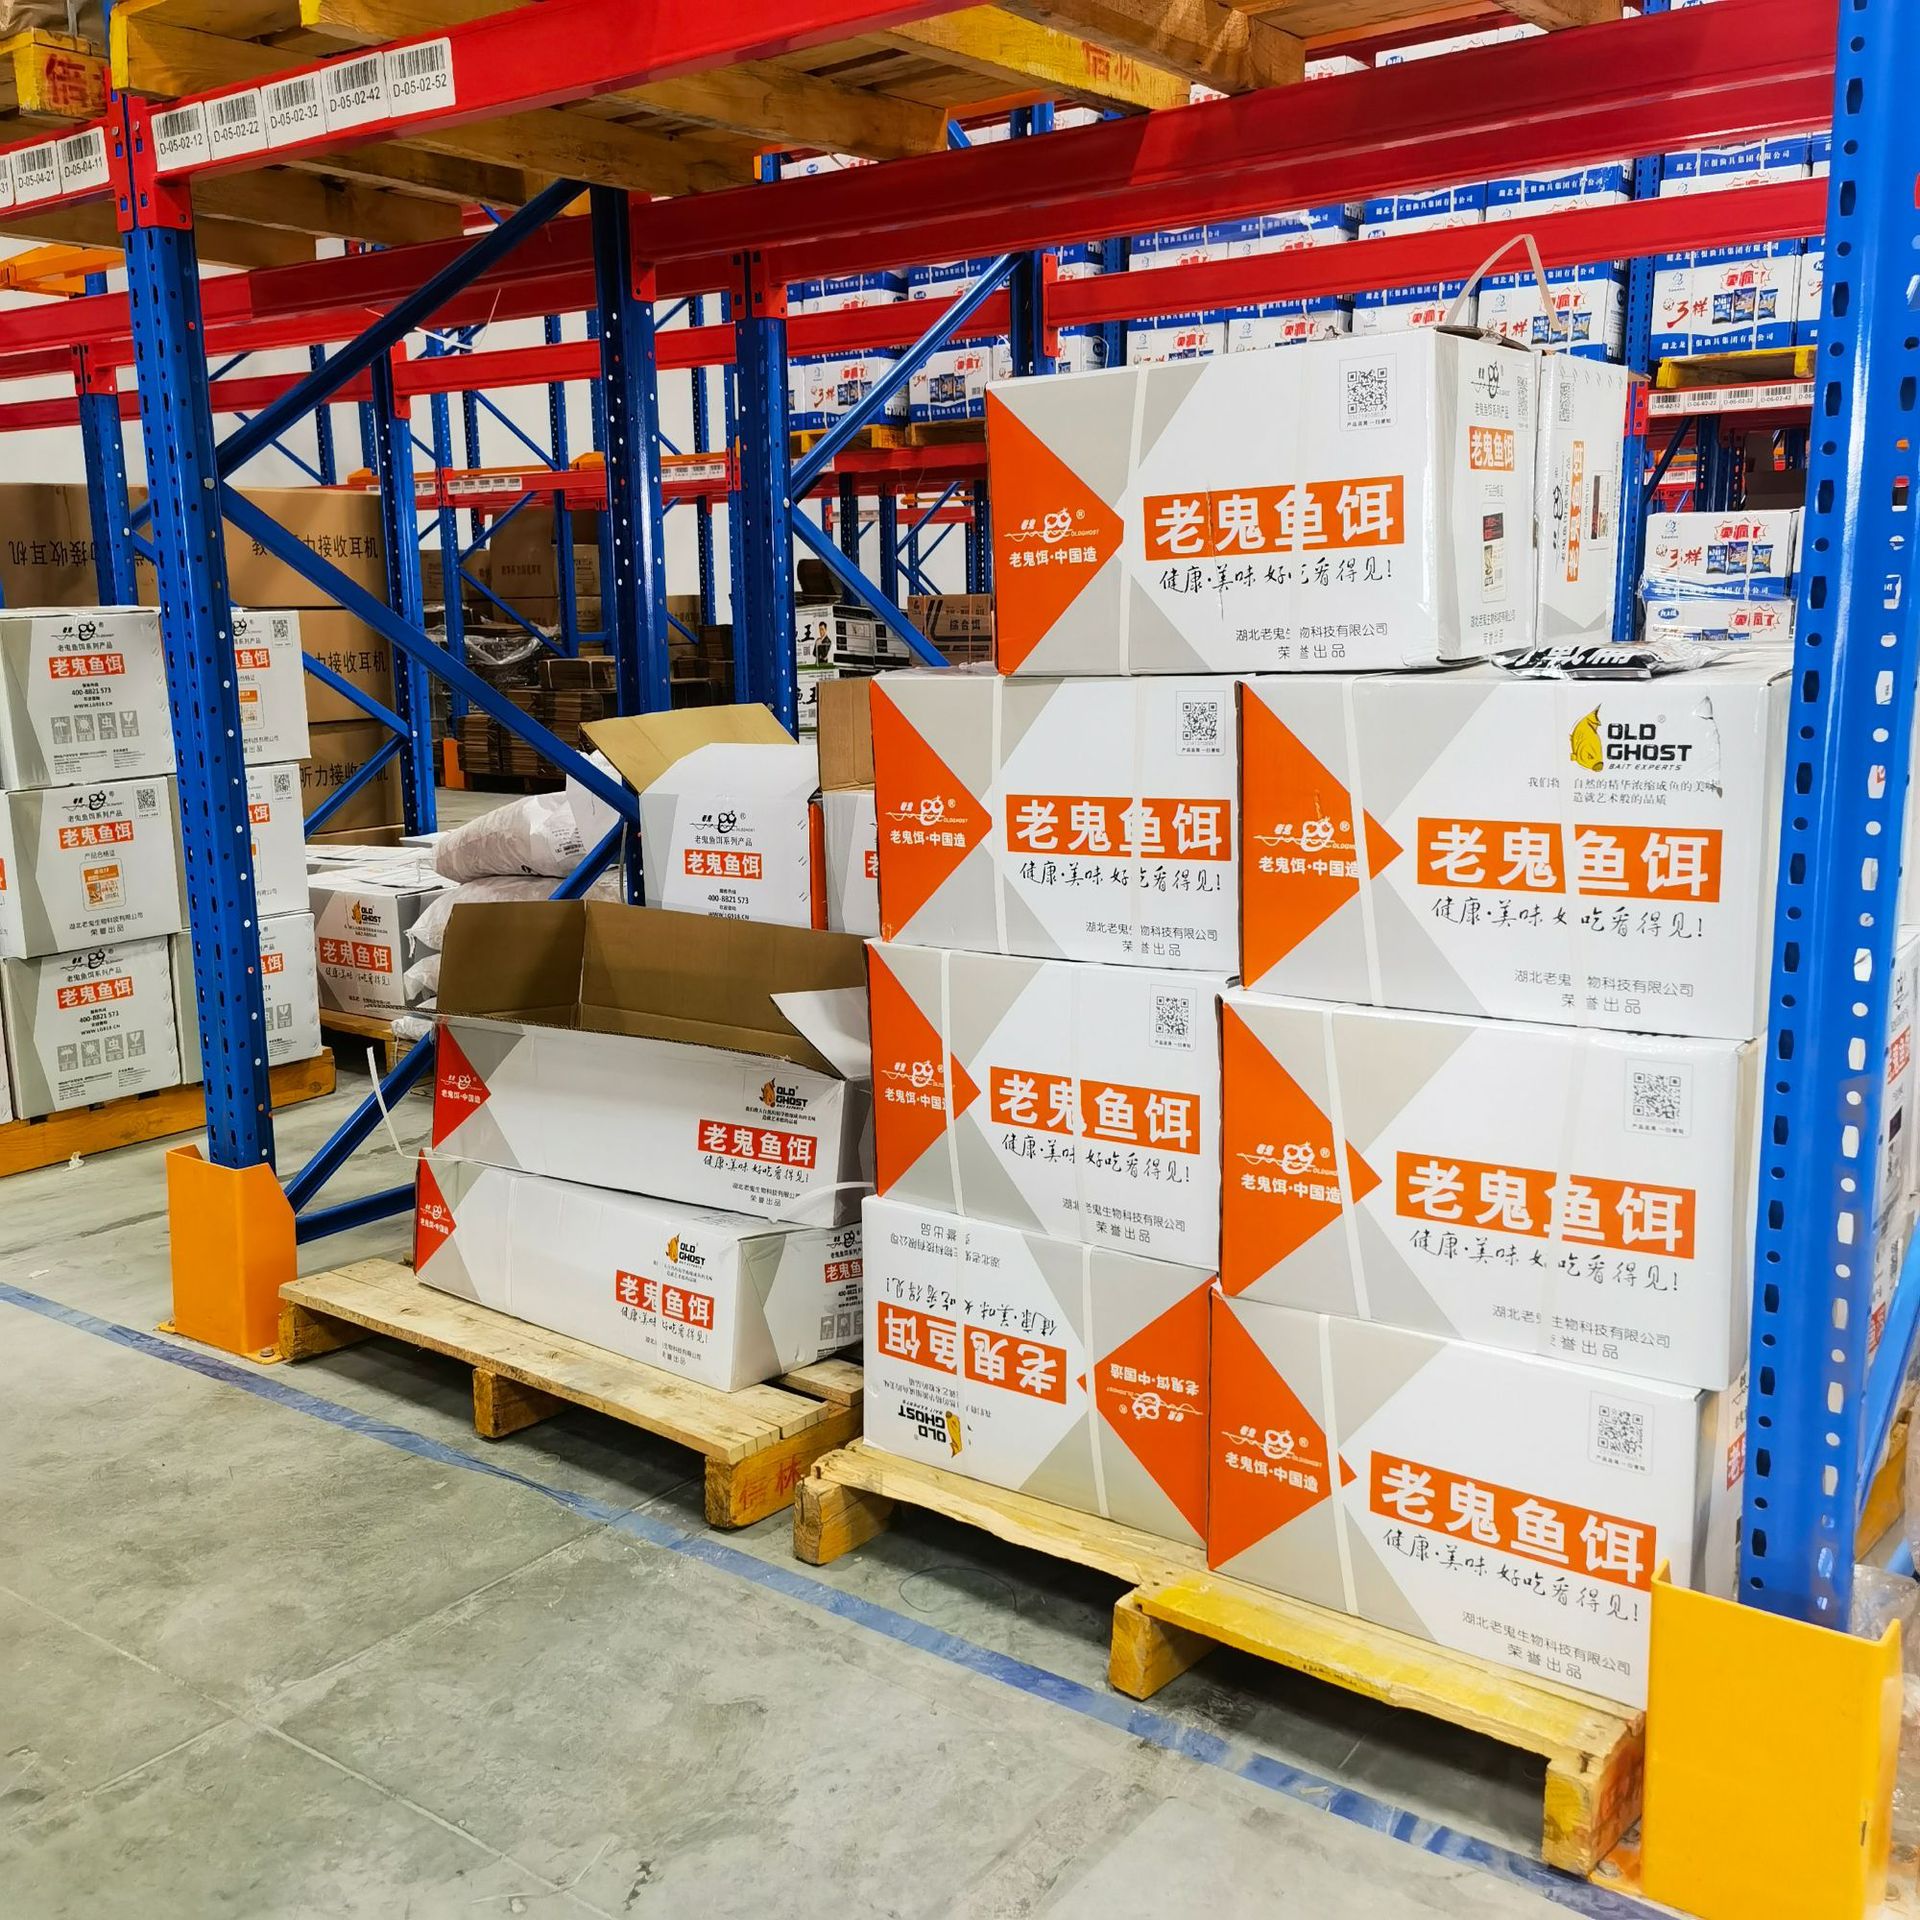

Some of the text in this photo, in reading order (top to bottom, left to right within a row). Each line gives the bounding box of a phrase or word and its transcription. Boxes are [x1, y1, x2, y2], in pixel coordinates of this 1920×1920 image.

[393, 73, 447, 98] D-05-02-52
[330, 86, 381, 113] D-05-02-42
[270, 104, 319, 129] D-05-02-32
[160, 134, 203, 155] D-05-02-12
[213, 121, 260, 143] D-05-02-22
[18, 170, 55, 188] D-05-04-21
[64, 156, 103, 178] D-05-04-11
[1471, 430, 1513, 468] 老鬼鱼饵
[1155, 483, 1395, 554] 老鬼鱼饵
[1009, 546, 1098, 568] 老鬼饵·中国造
[1158, 563, 1255, 595] 健康·美味
[52, 656, 122, 677] 老鬼鱼饵
[1607, 723, 1657, 740] OLD
[1606, 744, 1692, 762] GHOST
[1528, 777, 1720, 793] 我们将自然的精华浓缩成鱼的美味
[63, 822, 131, 847] 老鬼鱼饵
[695, 835, 753, 847] 老鬼鱼饵系列产品
[890, 829, 966, 848] 老鬼饵·中国造
[1015, 800, 1223, 856] 老鬼鱼饵
[687, 851, 760, 878] 老鬼鱼饵
[1258, 856, 1359, 878] 老鬼饵·中国造
[1429, 824, 1709, 897] 老鬼鱼饵
[1019, 861, 1104, 887] 健康·美味
[361, 914, 382, 924] GHOST
[1430, 897, 1543, 927] 健康·美味
[323, 940, 389, 971] 老鬼鱼饵
[62, 978, 131, 1007] 老鬼鱼饵
[1514, 968, 1694, 999] 湖北老鬼物科技有限公司
[1561, 993, 1641, 1015] 荣誉出品
[776, 1095, 808, 1108] GHOST
[777, 1086, 796, 1097] OLD
[999, 1073, 1193, 1150] 老鬼鱼饵
[704, 1124, 812, 1166] 老鬼鱼饵
[1085, 1149, 1190, 1184] 好吃看得见!
[1241, 1173, 1341, 1204] 老鬼饵·中国造
[1409, 1160, 1683, 1252] 老鬼鱼饵
[1095, 1220, 1151, 1243] 荣誉出品
[678, 1251, 706, 1266] GHOST
[680, 1242, 696, 1253] OLD
[1409, 1229, 1519, 1267] 健康·美味
[826, 1261, 862, 1281] 老鬼鱼
[620, 1275, 710, 1327] 老鬼鱼饵
[884, 1309, 1059, 1396] 老鬼鱼饵
[1110, 1363, 1200, 1396] 老鬼饵·中国造
[898, 1405, 946, 1428] GHOST
[918, 1425, 946, 1443] OLD
[1225, 1451, 1318, 1493] 老鬼饵·中国造
[1381, 1463, 1644, 1584] 老鬼鱼饵
[1383, 1528, 1639, 1624] 健康·美味 好吃看得见!
[1462, 1610, 1631, 1677] 湖北老鬼生物科技有限公司
[1507, 1642, 1582, 1681] 荣誉出品
